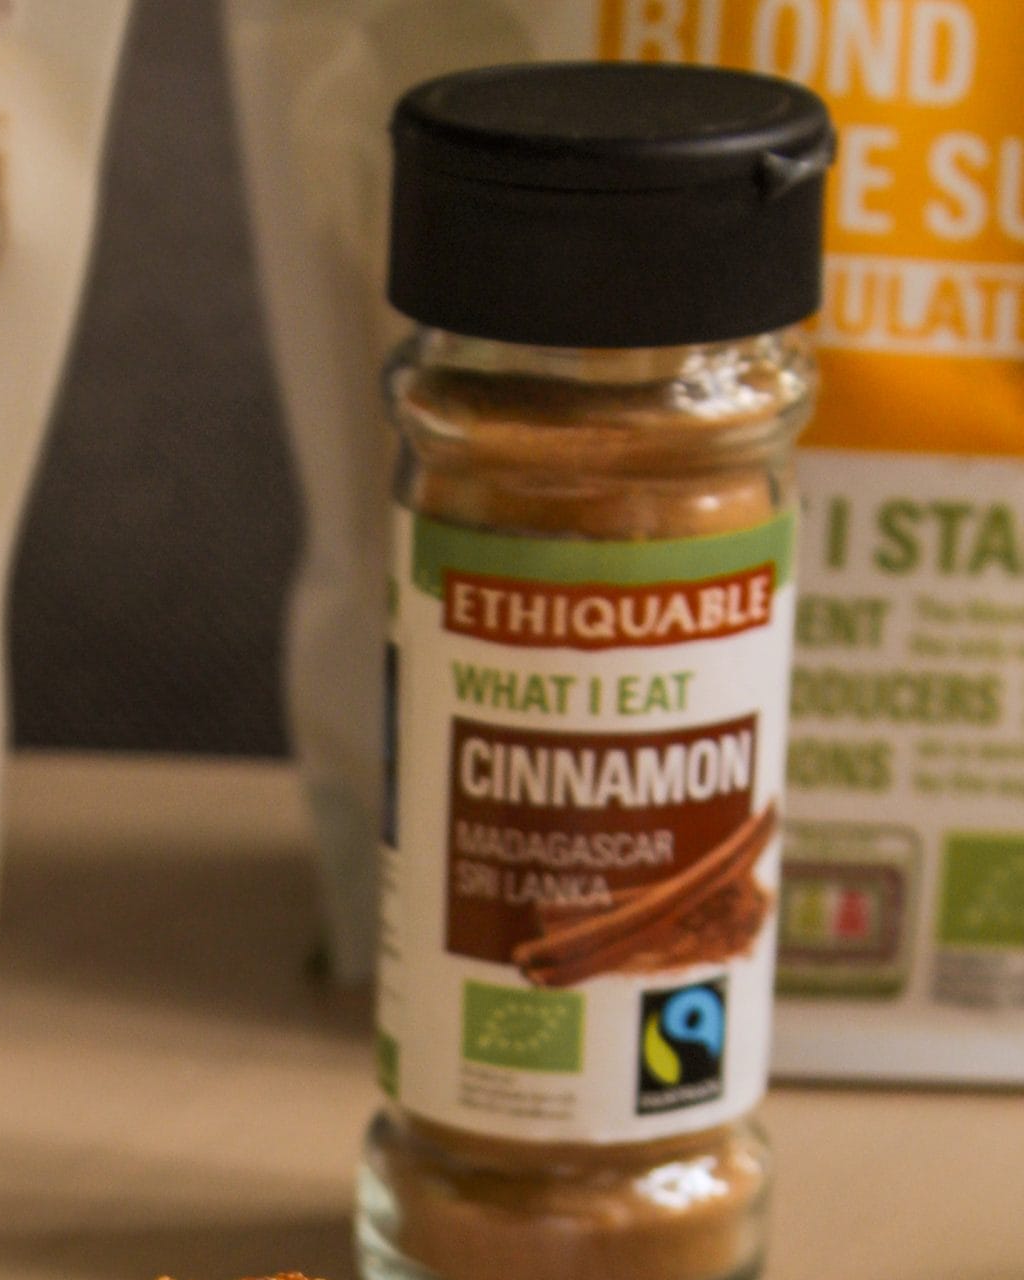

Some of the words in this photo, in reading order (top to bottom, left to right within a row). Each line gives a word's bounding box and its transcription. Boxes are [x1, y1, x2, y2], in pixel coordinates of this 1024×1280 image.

[827, 494, 852, 572] I
[451, 574, 772, 639] ETHIQUABLE
[451, 661, 577, 715] WHAT
[587, 675, 603, 716] I
[615, 669, 695, 716] EAT
[460, 730, 754, 808] CINNAMON
[455, 819, 675, 869] MADAGASCAR
[502, 868, 614, 908] LANKA
